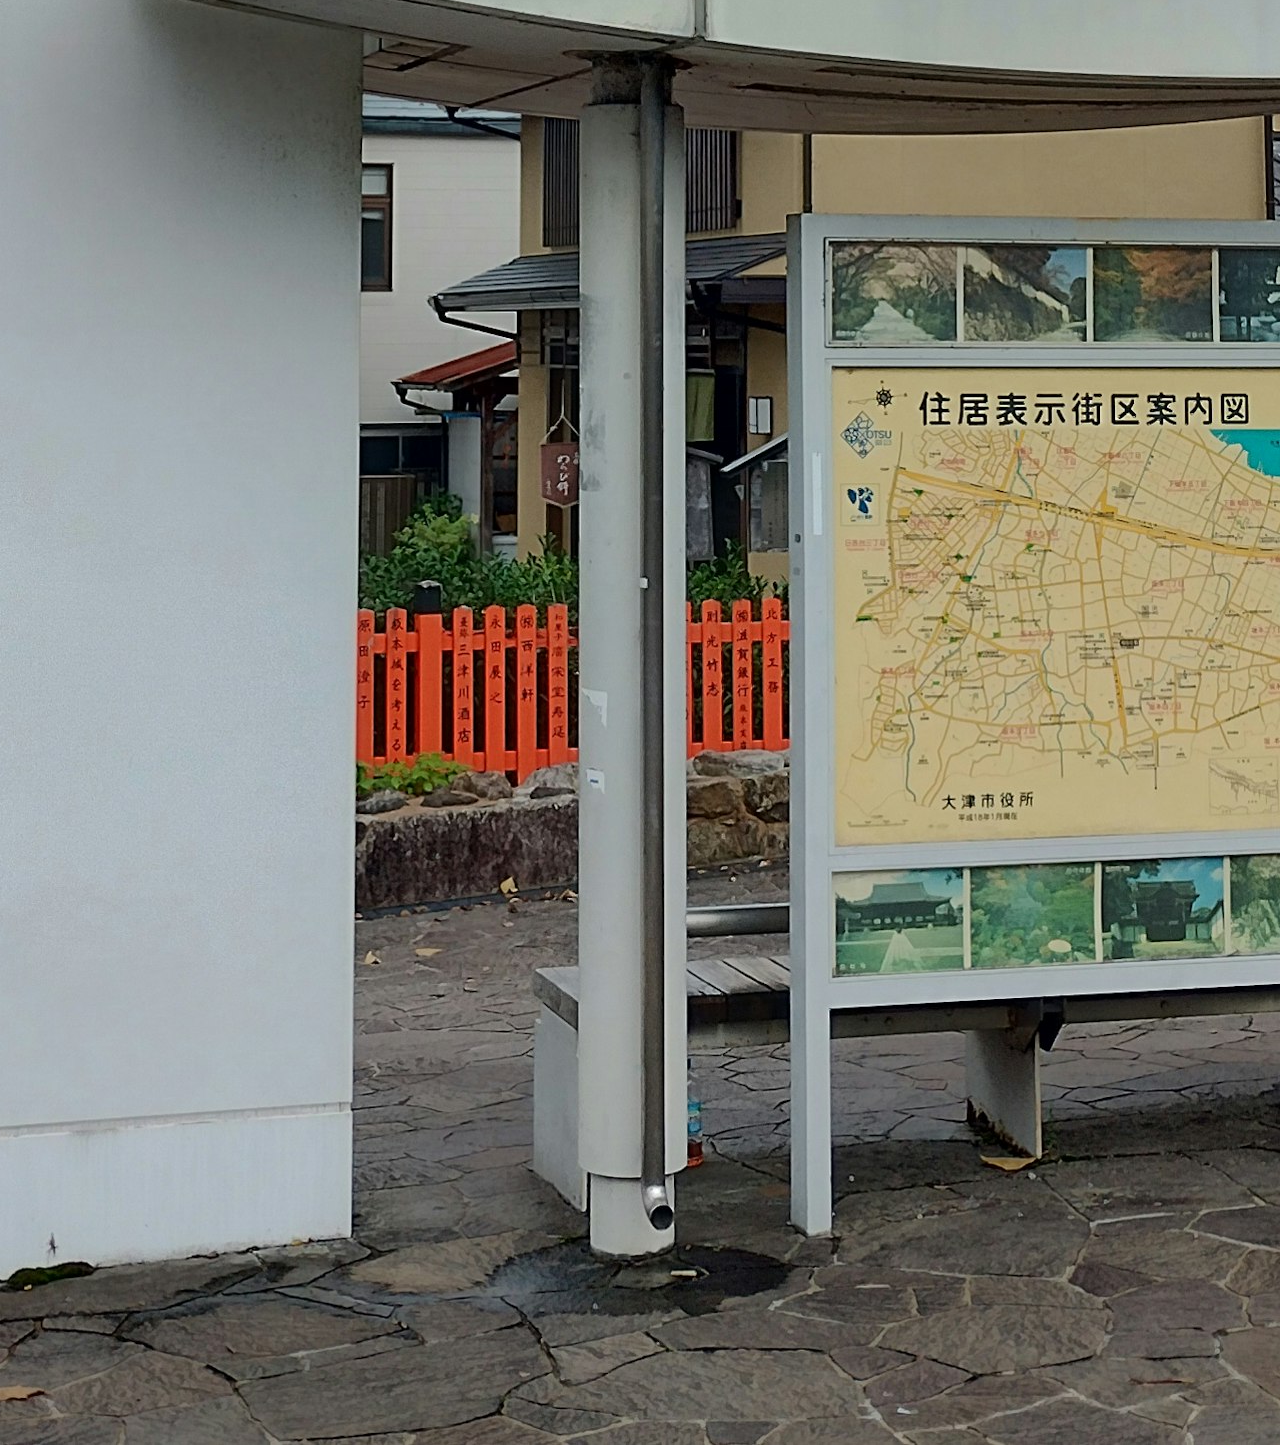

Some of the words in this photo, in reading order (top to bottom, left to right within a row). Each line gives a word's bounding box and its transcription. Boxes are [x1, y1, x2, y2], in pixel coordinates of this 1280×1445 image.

[919, 392, 1250, 426] 住居表示街区案内図
[941, 791, 1034, 810] 大津市役所
